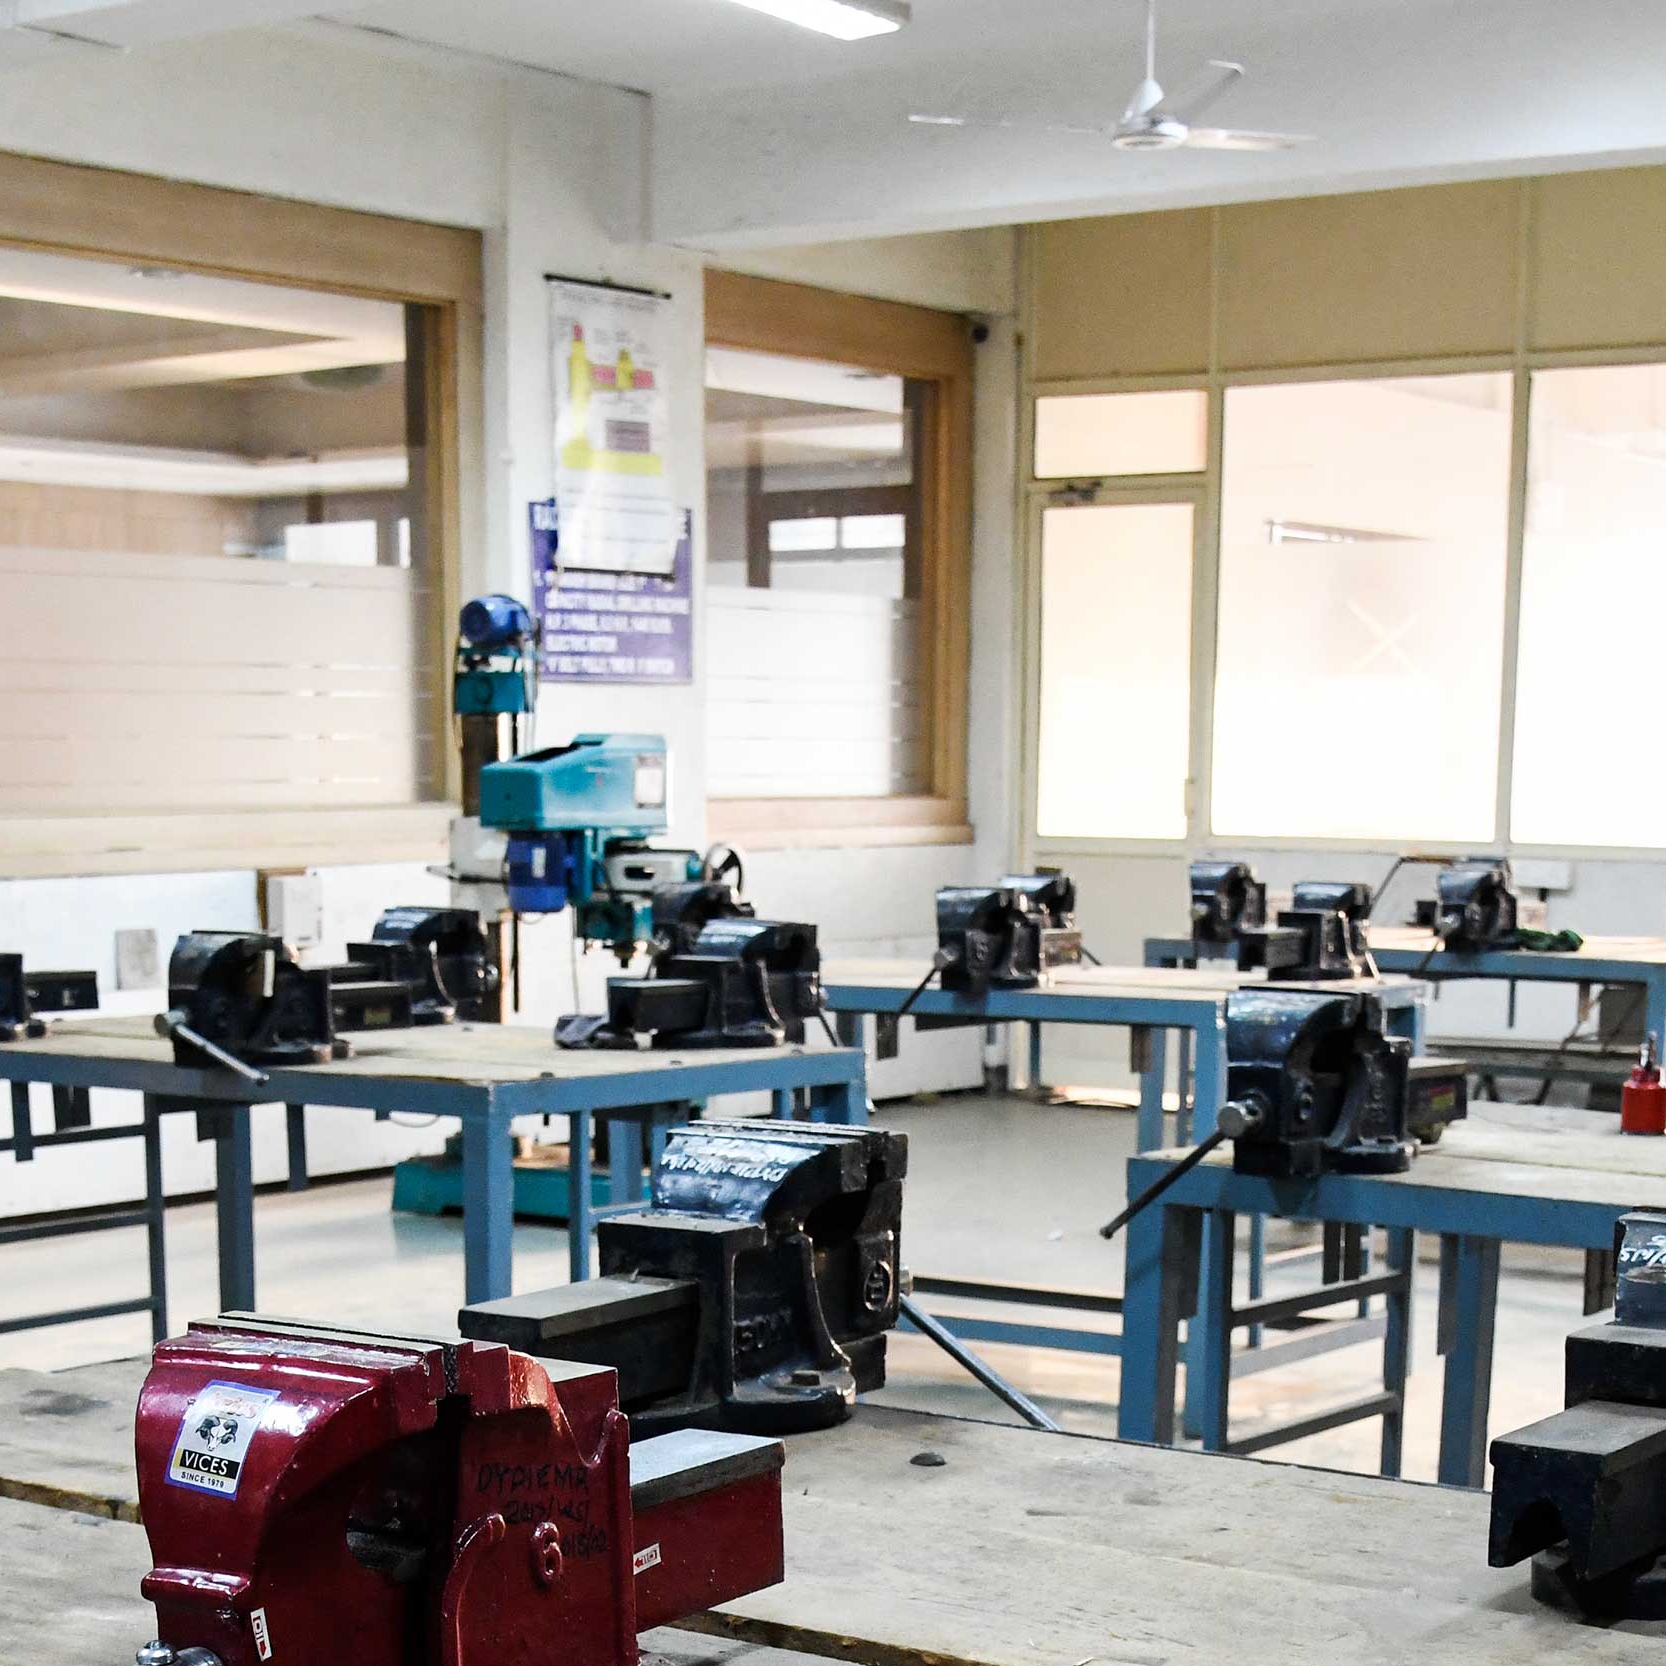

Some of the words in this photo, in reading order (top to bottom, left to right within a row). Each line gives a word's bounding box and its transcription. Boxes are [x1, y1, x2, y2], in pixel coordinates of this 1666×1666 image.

[184, 1451, 229, 1476] VICES
[181, 1471, 205, 1484] SINCE
[207, 1477, 225, 1488] 1979
